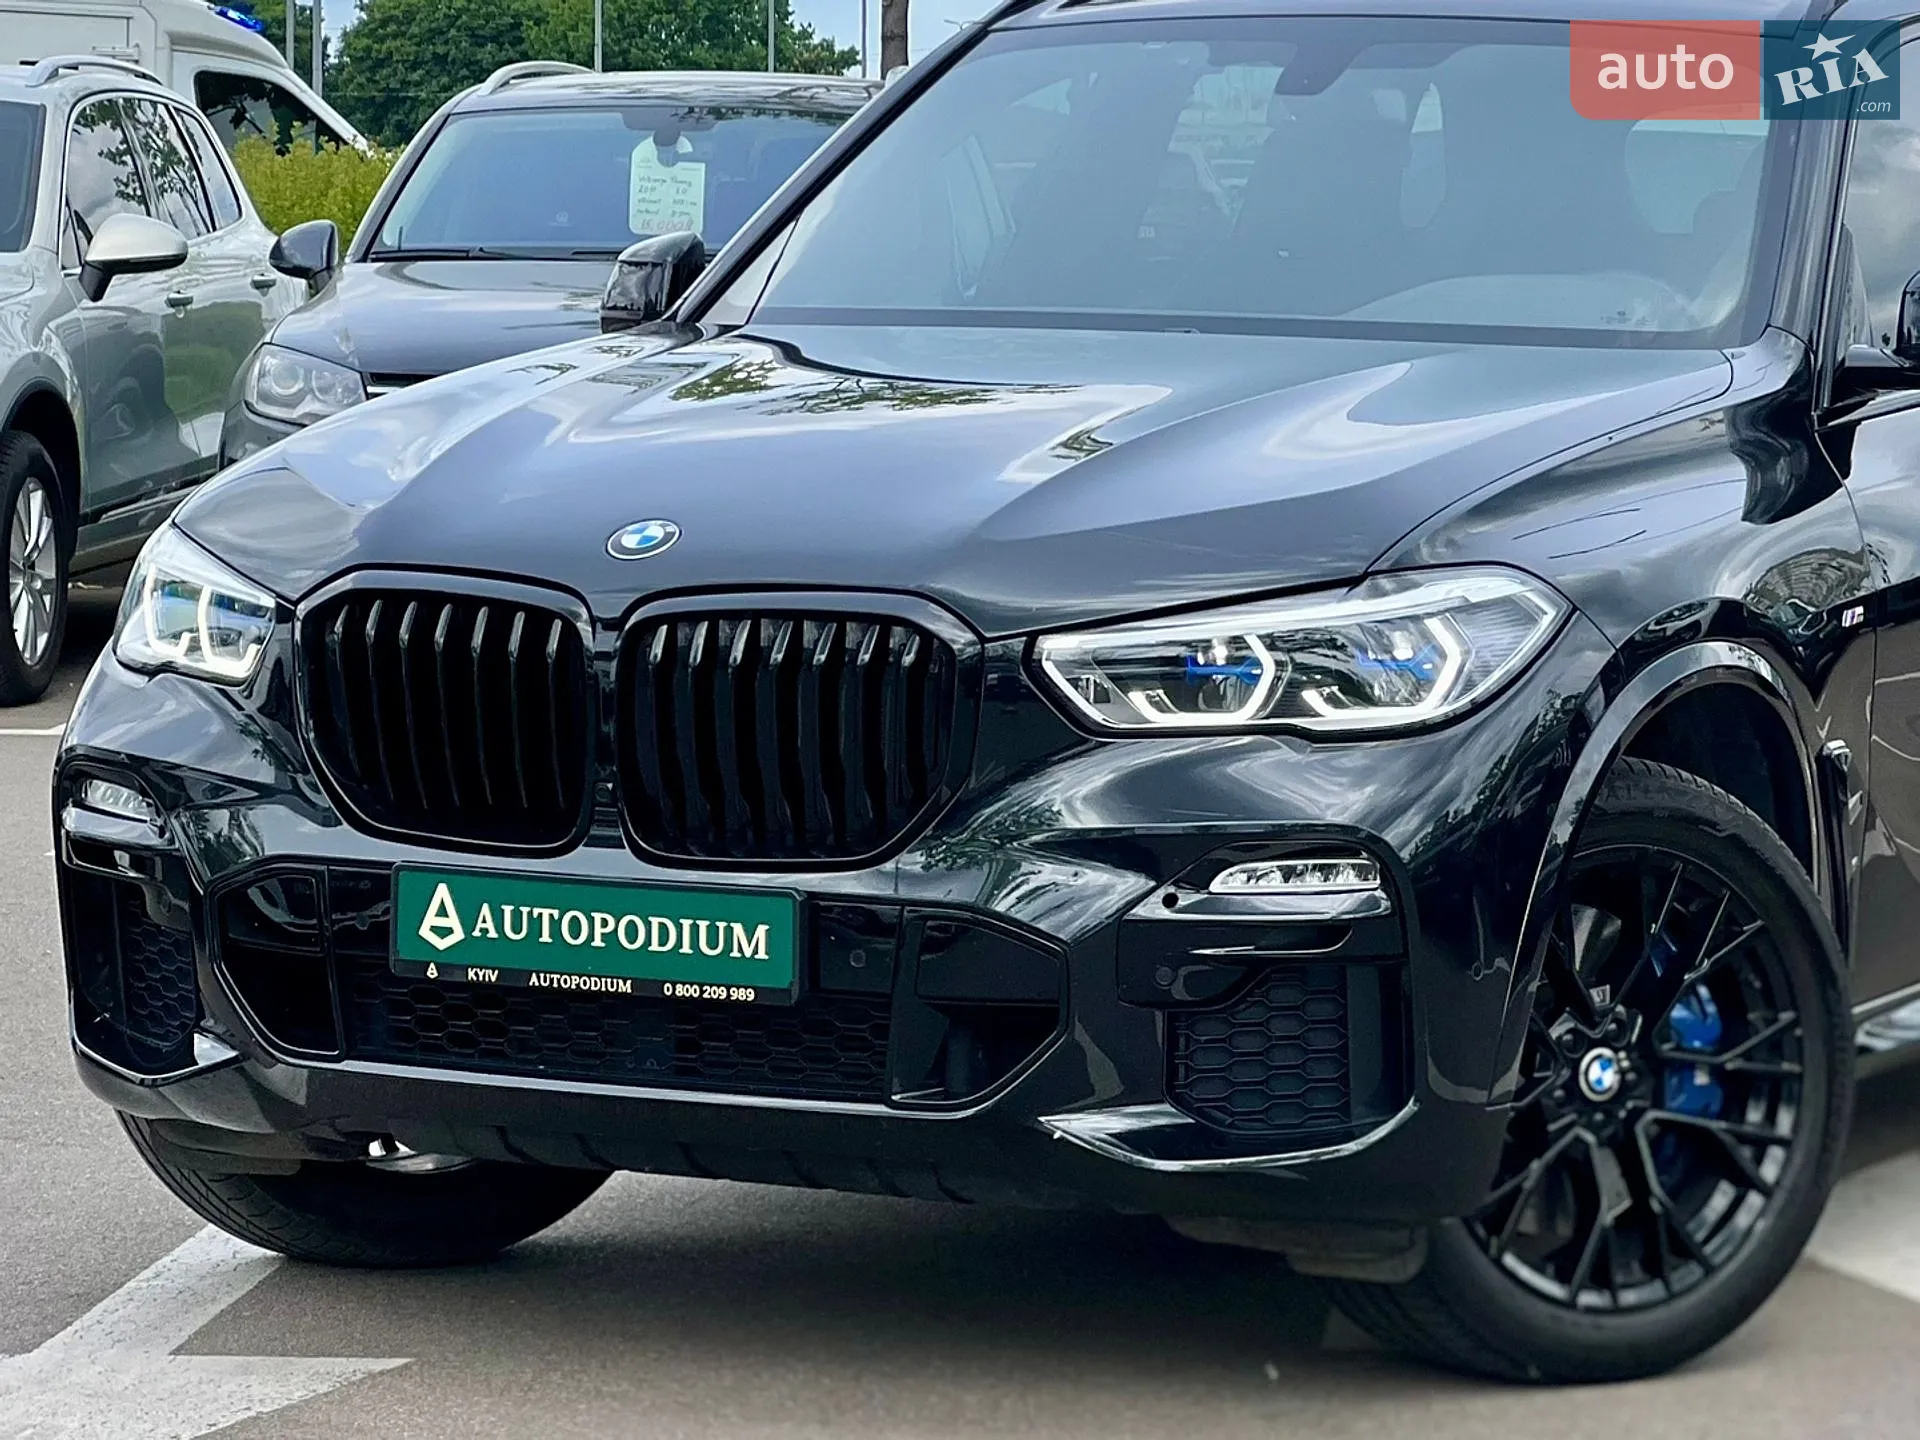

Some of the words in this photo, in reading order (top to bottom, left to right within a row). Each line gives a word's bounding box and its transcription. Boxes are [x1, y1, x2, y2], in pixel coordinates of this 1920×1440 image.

[471, 902, 771, 961] AUTOPODIUM
[467, 967, 499, 983] KYIV
[529, 972, 632, 993] AUTOPODIUM
[674, 984, 700, 998] 800
[702, 985, 728, 999] 209
[729, 987, 755, 1001] 989
